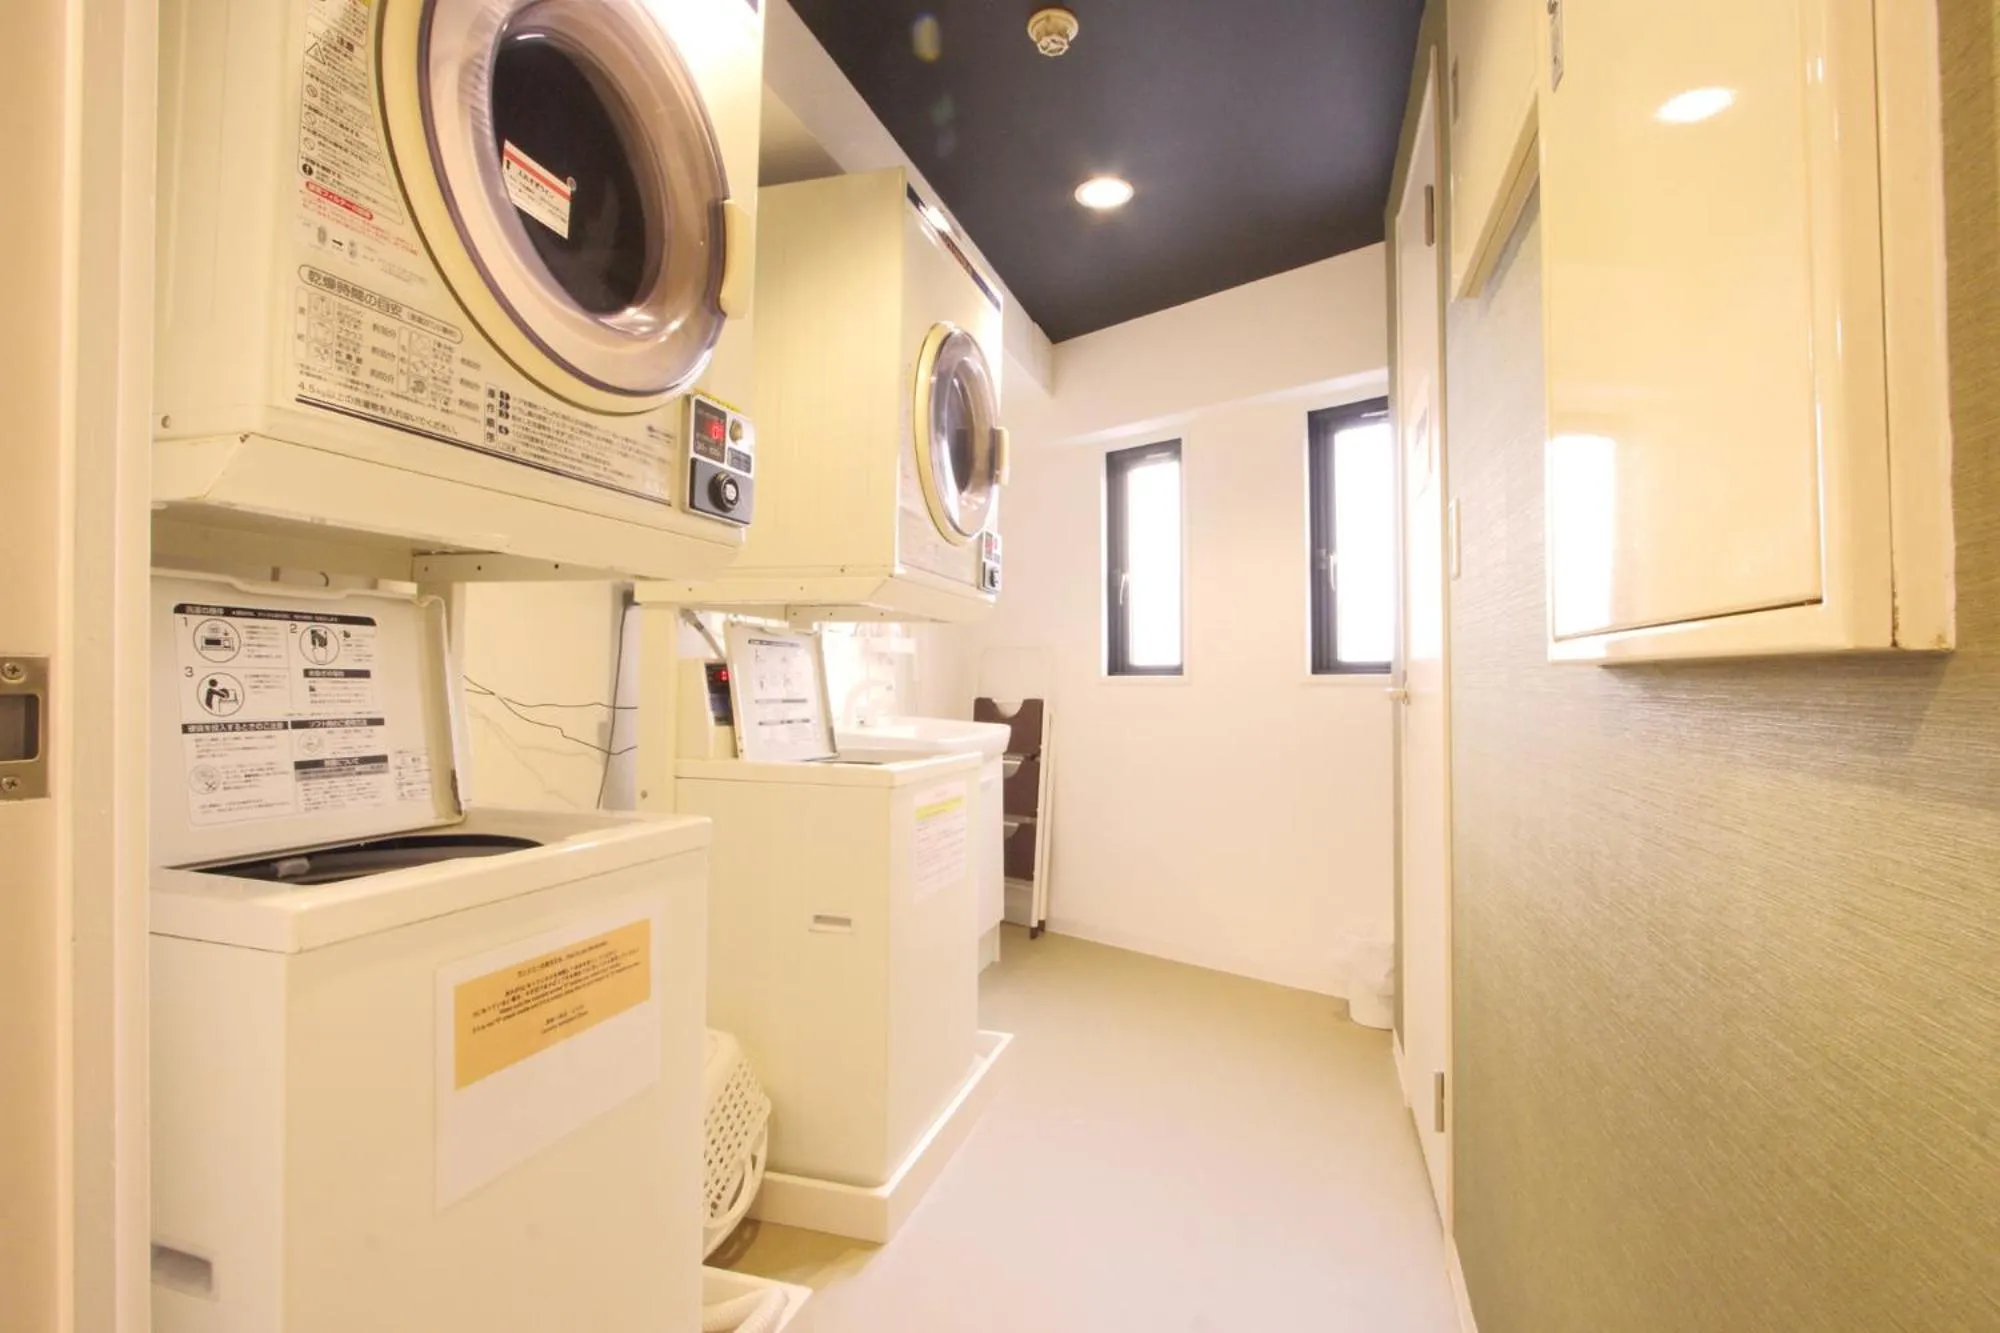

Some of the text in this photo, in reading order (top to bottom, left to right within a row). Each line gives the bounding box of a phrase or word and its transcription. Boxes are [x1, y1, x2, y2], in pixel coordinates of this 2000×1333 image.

[308, 269, 402, 318] 乾燥時間の目安
[183, 616, 189, 627] 1
[289, 623, 298, 634] 2
[184, 666, 194, 678] 3
